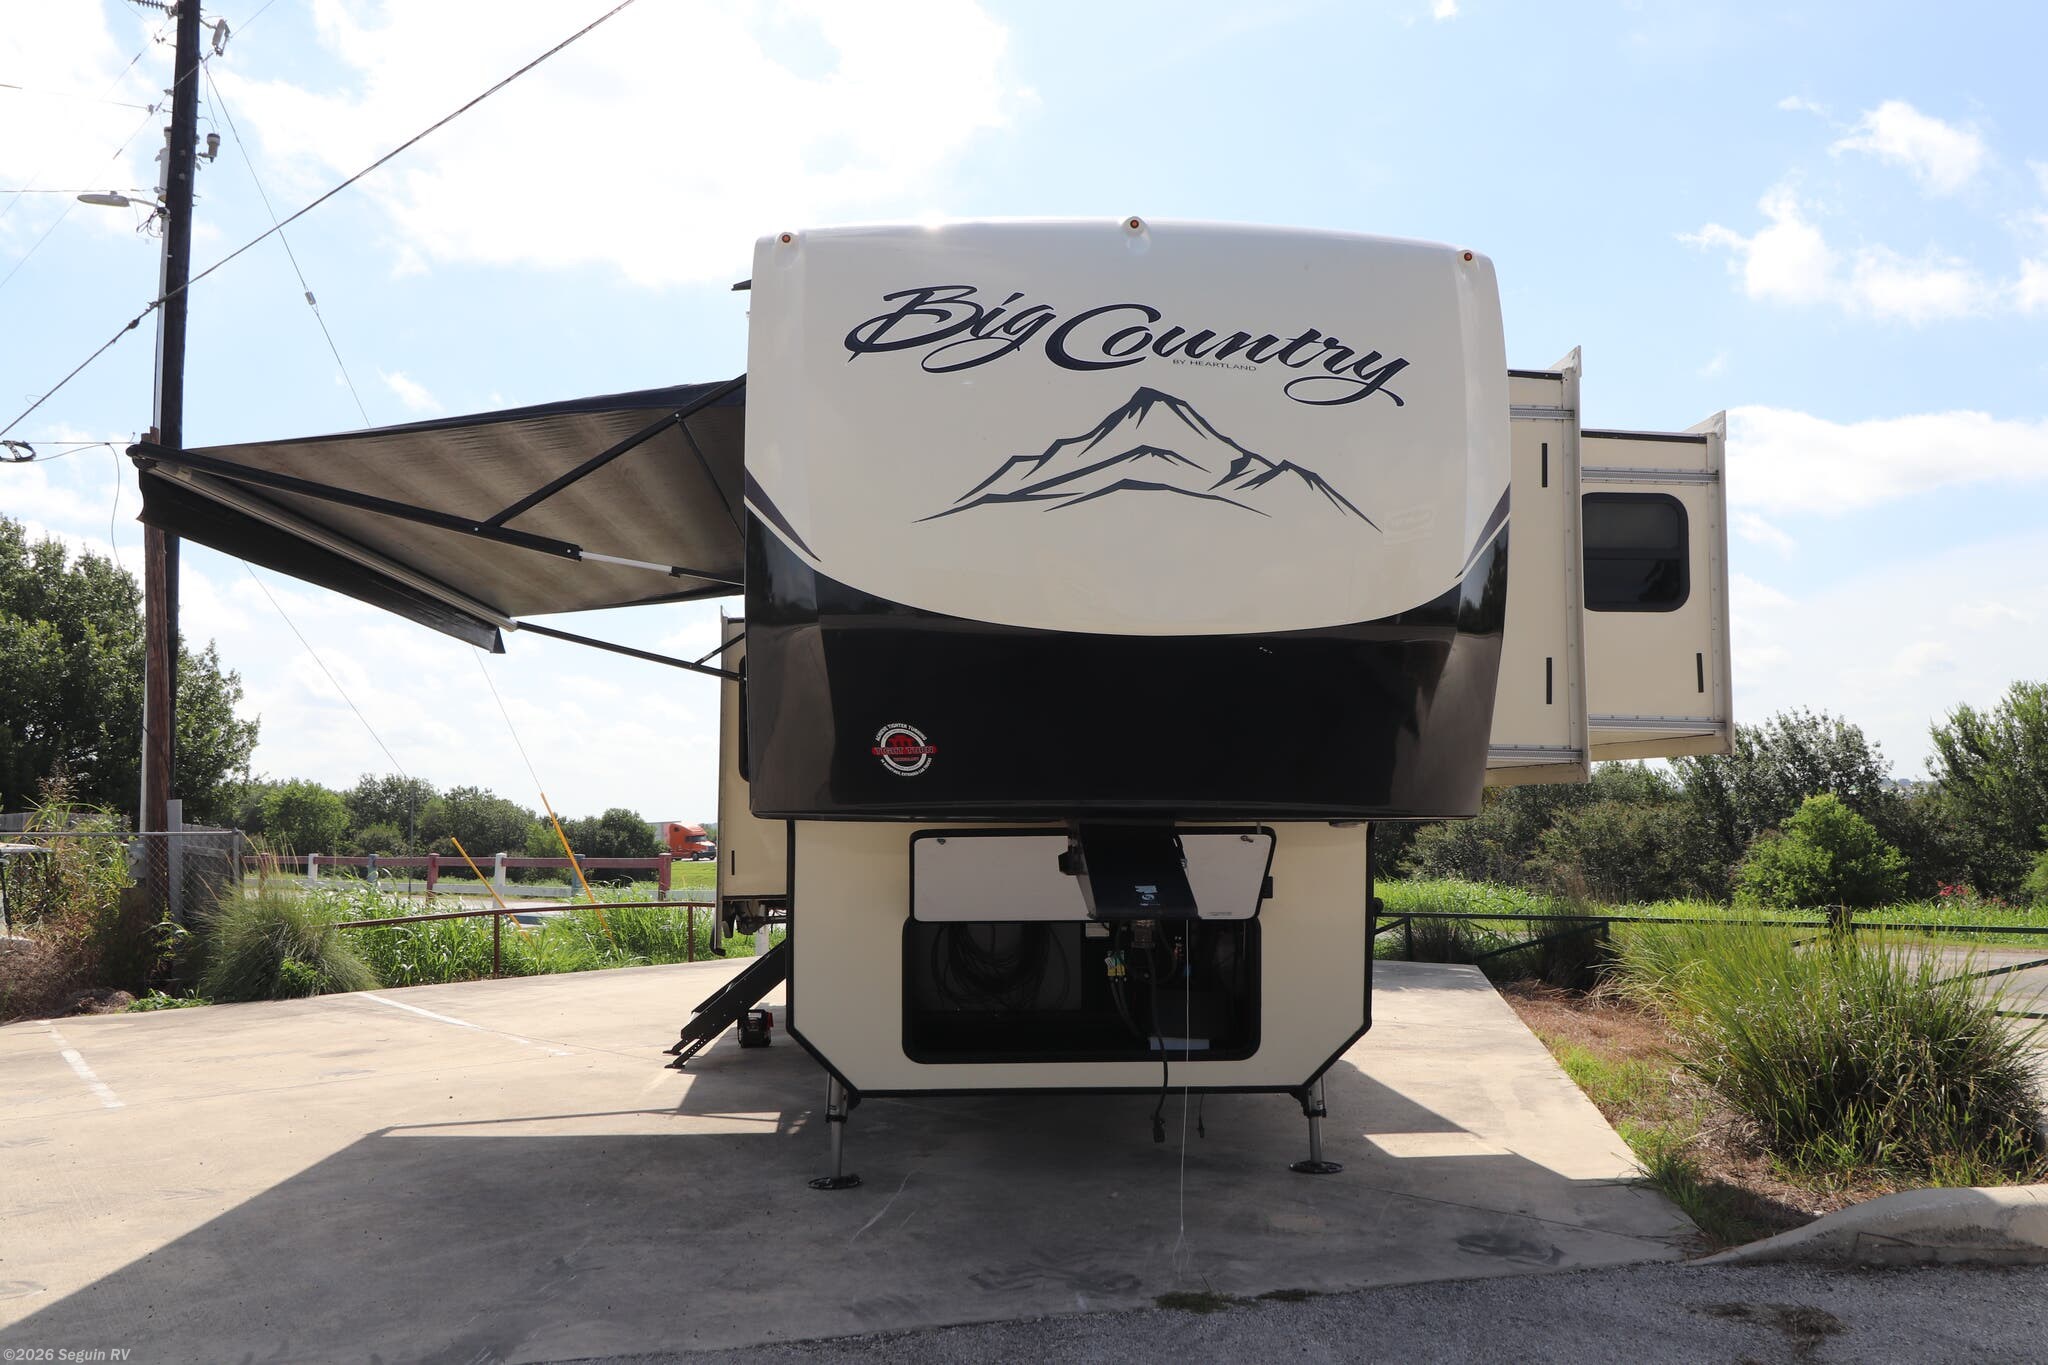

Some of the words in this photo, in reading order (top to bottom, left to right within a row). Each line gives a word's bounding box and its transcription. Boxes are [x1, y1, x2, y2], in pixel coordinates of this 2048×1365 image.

[843, 285, 1058, 373] Big
[1045, 303, 1411, 407] Country
[1190, 360, 1257, 372] HEARTLAND
